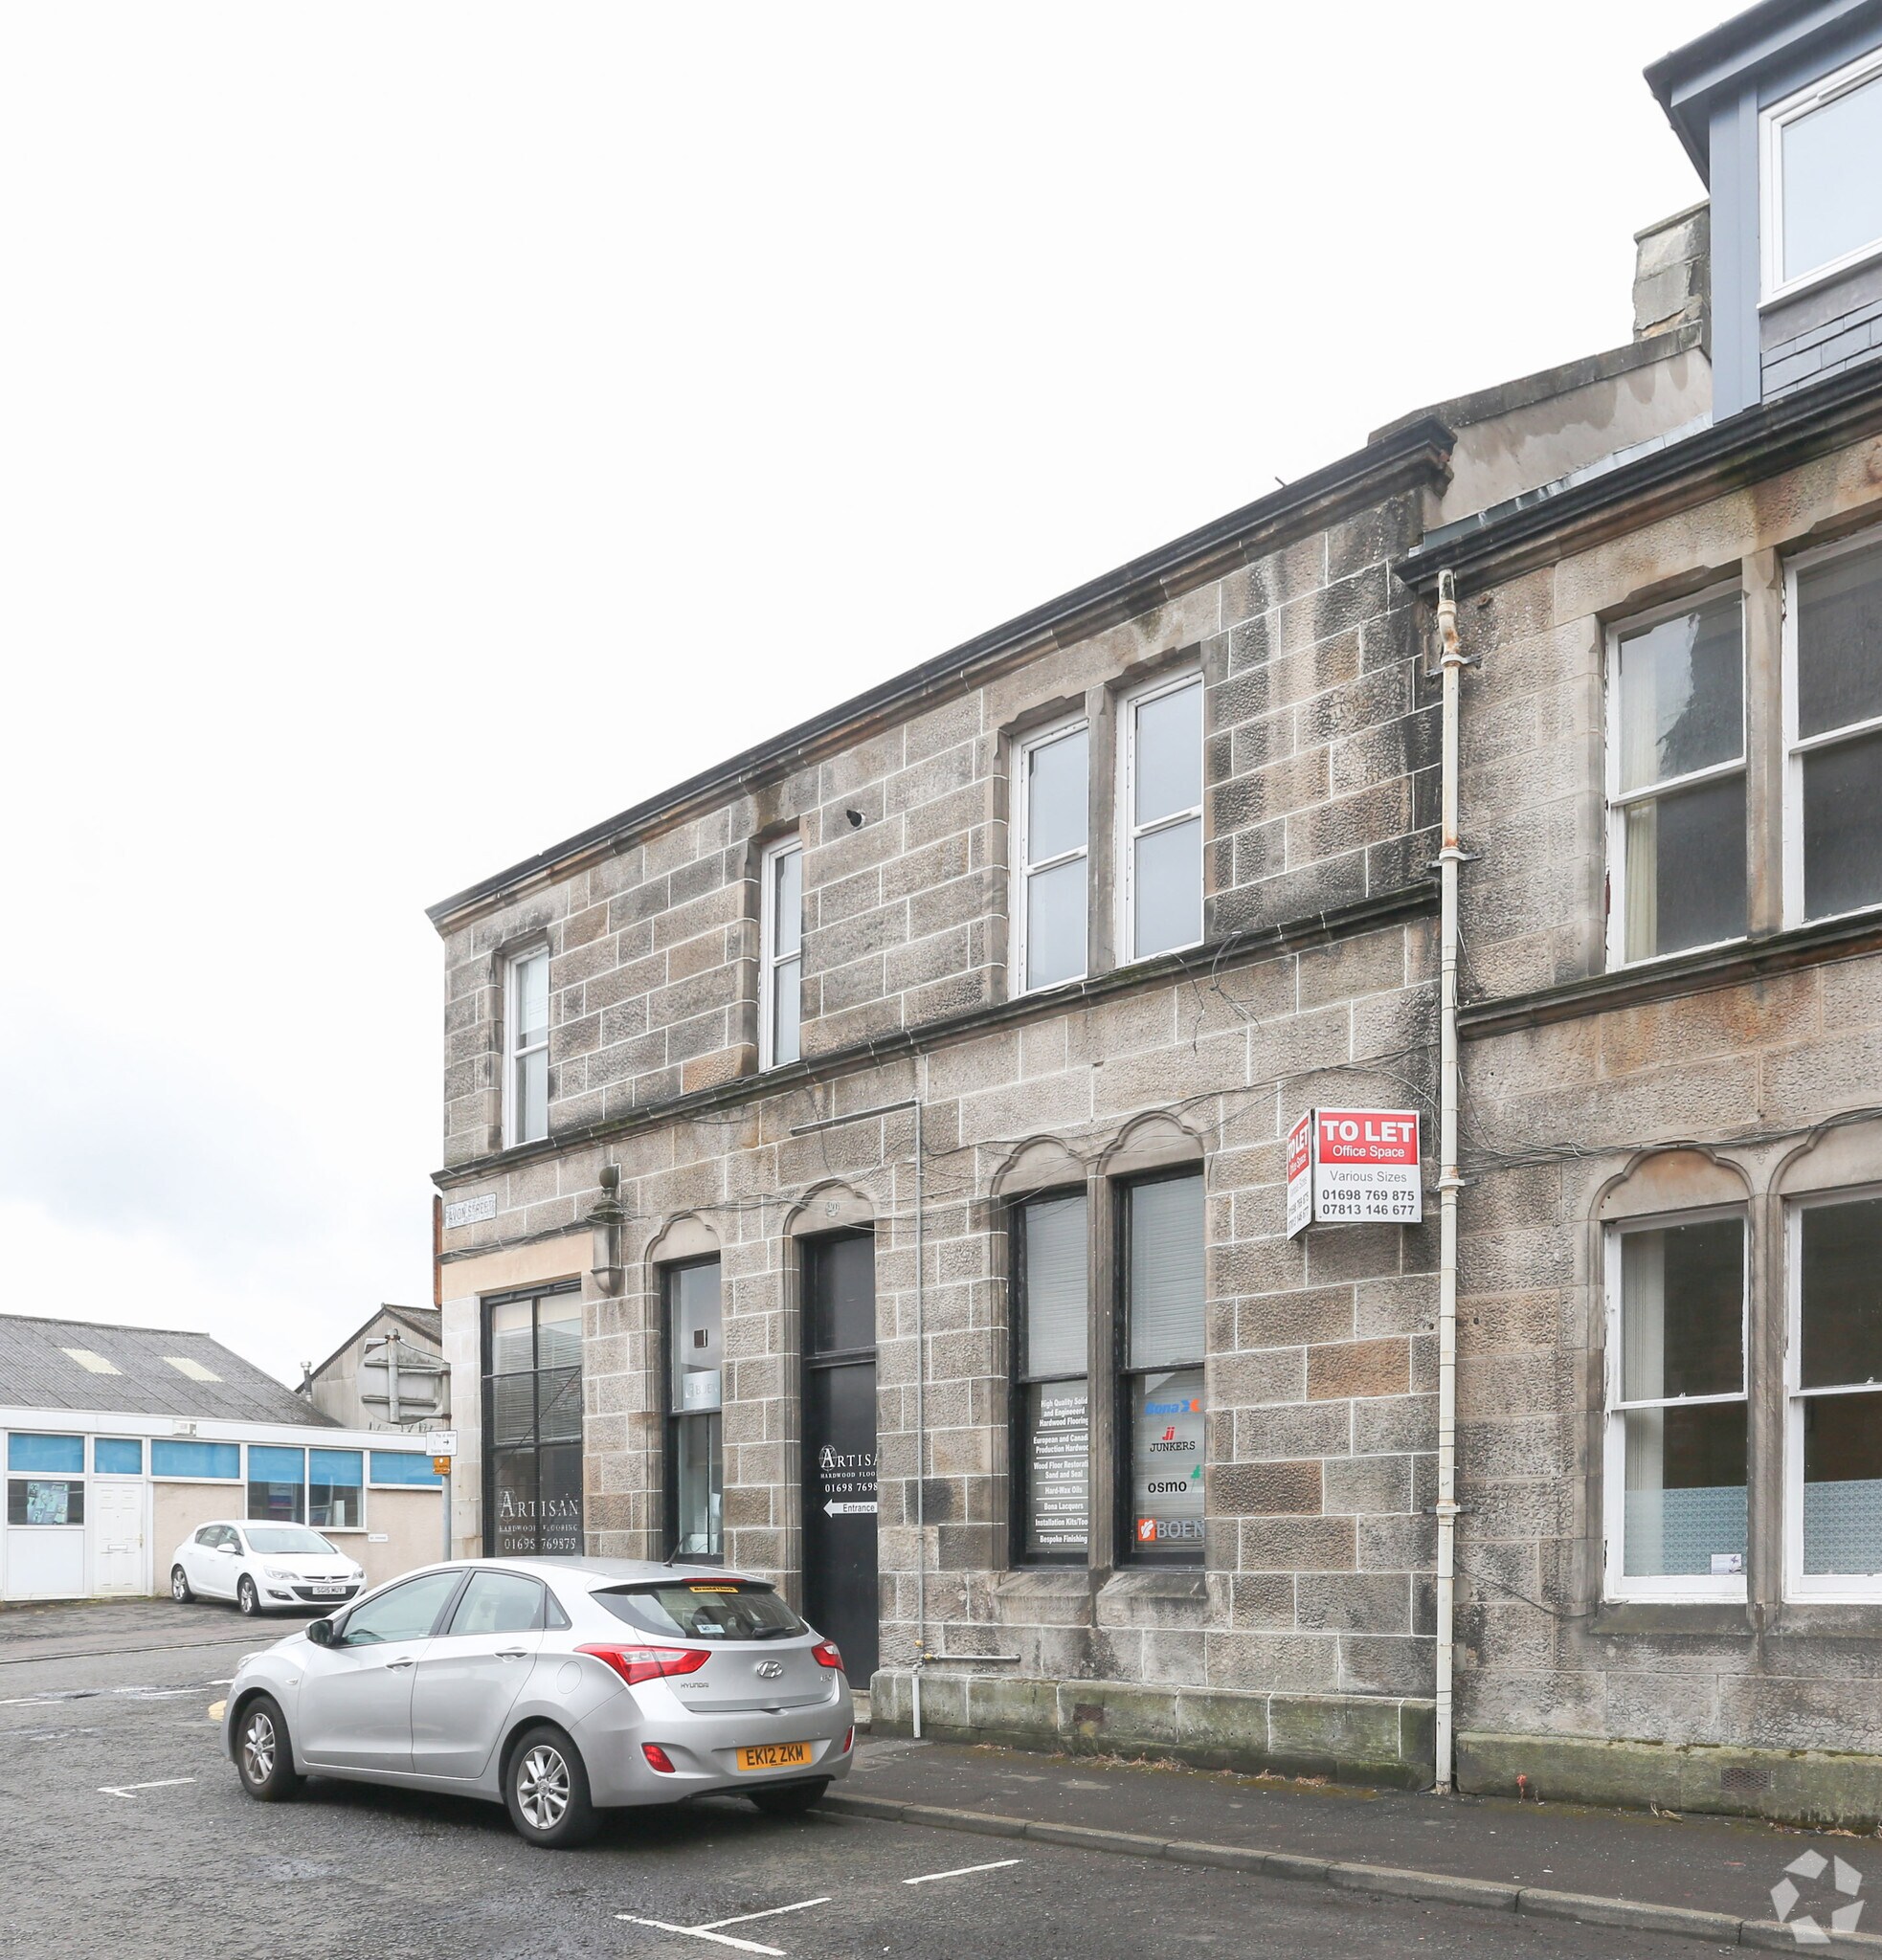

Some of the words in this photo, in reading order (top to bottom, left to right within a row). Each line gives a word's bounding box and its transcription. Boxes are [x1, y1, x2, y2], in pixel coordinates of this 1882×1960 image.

[1321, 1120, 1359, 1142] TO
[1364, 1121, 1415, 1143] LET
[1296, 1125, 1309, 1154] LET
[1333, 1145, 1366, 1157] Office
[1369, 1146, 1405, 1159] Space
[1330, 1170, 1373, 1182] Various
[1377, 1171, 1407, 1182] Sizes
[1322, 1190, 1361, 1200] 01698
[1365, 1190, 1388, 1201] 769
[1392, 1191, 1415, 1201] 875
[468, 1198, 494, 1216] STREET
[1322, 1204, 1361, 1214] 07813
[1366, 1204, 1388, 1214] 146
[1392, 1205, 1415, 1215] 677
[1041, 1399, 1053, 1409] High
[1054, 1398, 1073, 1408] Quality
[1074, 1396, 1087, 1405] Solid
[1144, 1402, 1179, 1414] Bona
[1040, 1417, 1066, 1427] Hardwood
[1067, 1416, 1088, 1426] Flooring
[1034, 1437, 1058, 1445] European
[1150, 1441, 1196, 1452] JUNKERS
[1036, 1445, 1064, 1454] Production
[1034, 1461, 1048, 1470] Wood
[1049, 1460, 1064, 1469] Floor
[825, 1483, 853, 1492] 01698
[1148, 1481, 1187, 1493] osmo
[500, 1491, 579, 1517] ARTISAN
[842, 1503, 875, 1512] Entrance
[1059, 1503, 1084, 1511] Lacquers
[1040, 1535, 1063, 1545] Bespoke
[1064, 1534, 1088, 1545] Finishing
[746, 1748, 776, 1766] EK12
[779, 1745, 804, 1762] ZKM
